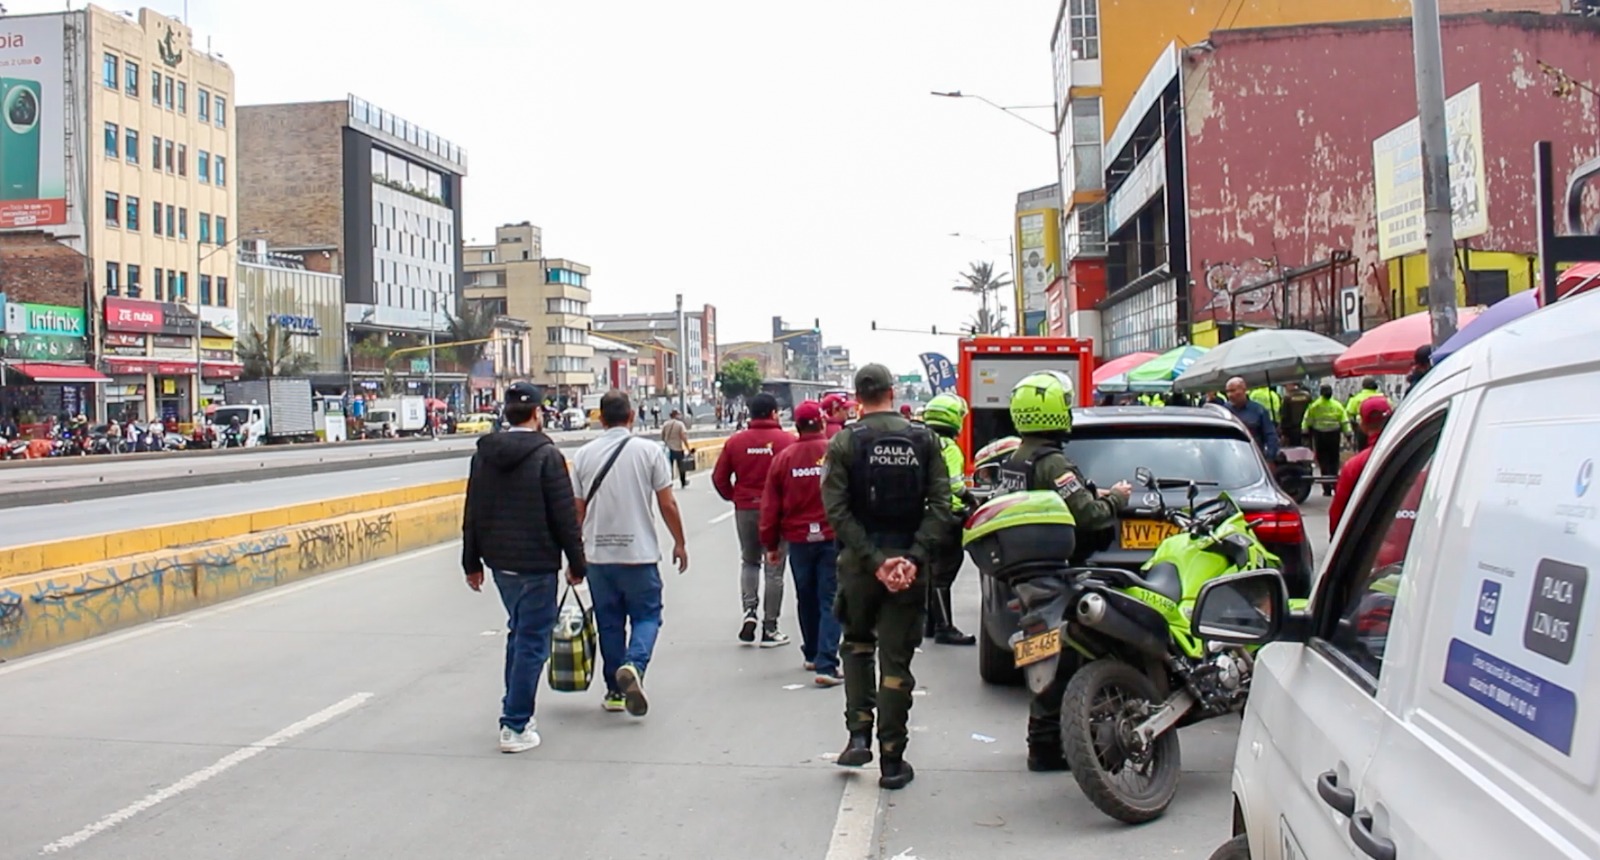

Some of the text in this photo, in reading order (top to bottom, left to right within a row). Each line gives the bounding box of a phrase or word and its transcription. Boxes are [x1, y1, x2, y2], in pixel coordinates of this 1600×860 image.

[119, 309, 132, 320] ZTE
[133, 311, 153, 322] nubia
[1345, 292, 1355, 329] P
[31, 309, 79, 332] Infinix
[873, 445, 914, 456] GAULA
[869, 454, 919, 466] POLICÍA
[793, 466, 827, 478] BOGOT
[1541, 576, 1573, 604] PLACA
